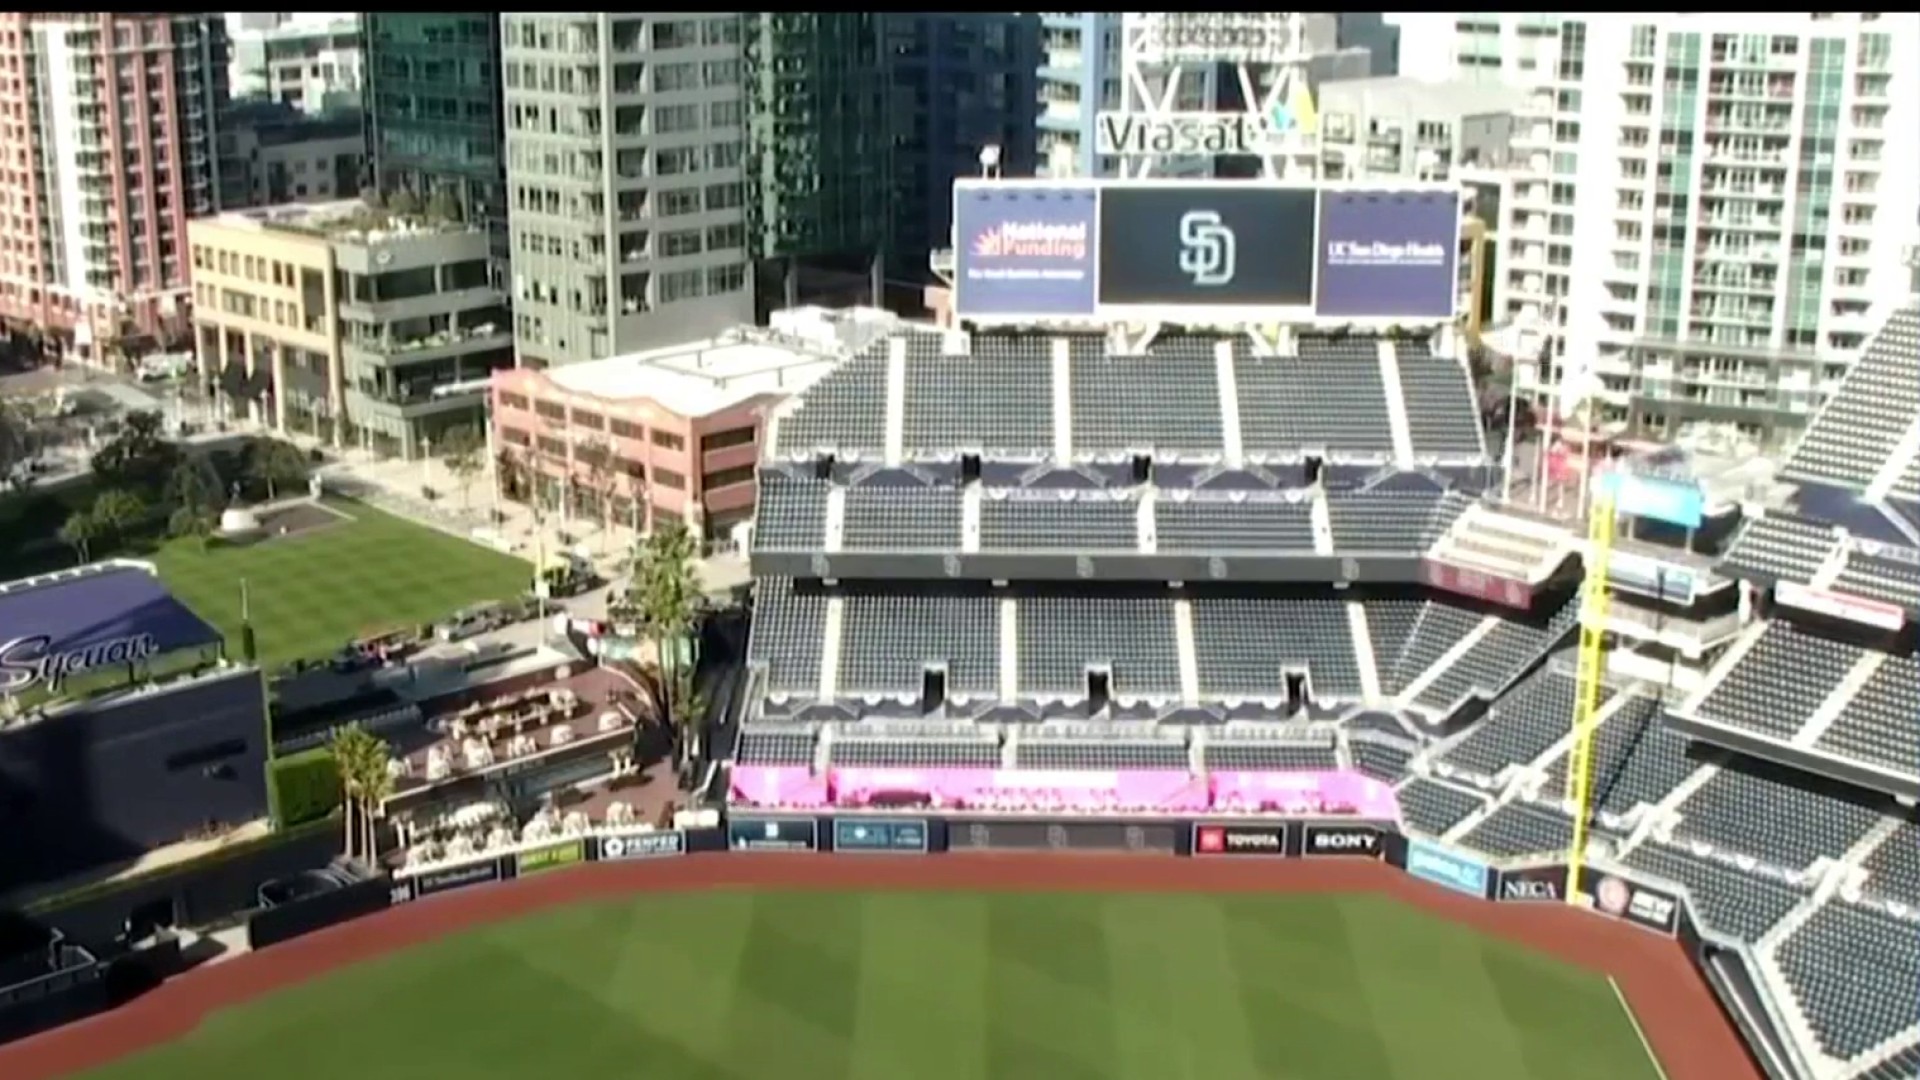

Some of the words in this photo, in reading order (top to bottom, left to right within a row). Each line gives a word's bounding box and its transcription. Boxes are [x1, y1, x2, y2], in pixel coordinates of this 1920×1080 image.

[1106, 115, 1246, 152] Viasat
[1001, 221, 1086, 241] National
[1002, 239, 1086, 259] Funding
[1180, 210, 1235, 285] SD
[0, 633, 159, 695] Sycuan
[1226, 833, 1279, 847] TOYOTA
[1314, 832, 1376, 849] SONY
[1504, 881, 1557, 898] NECA
